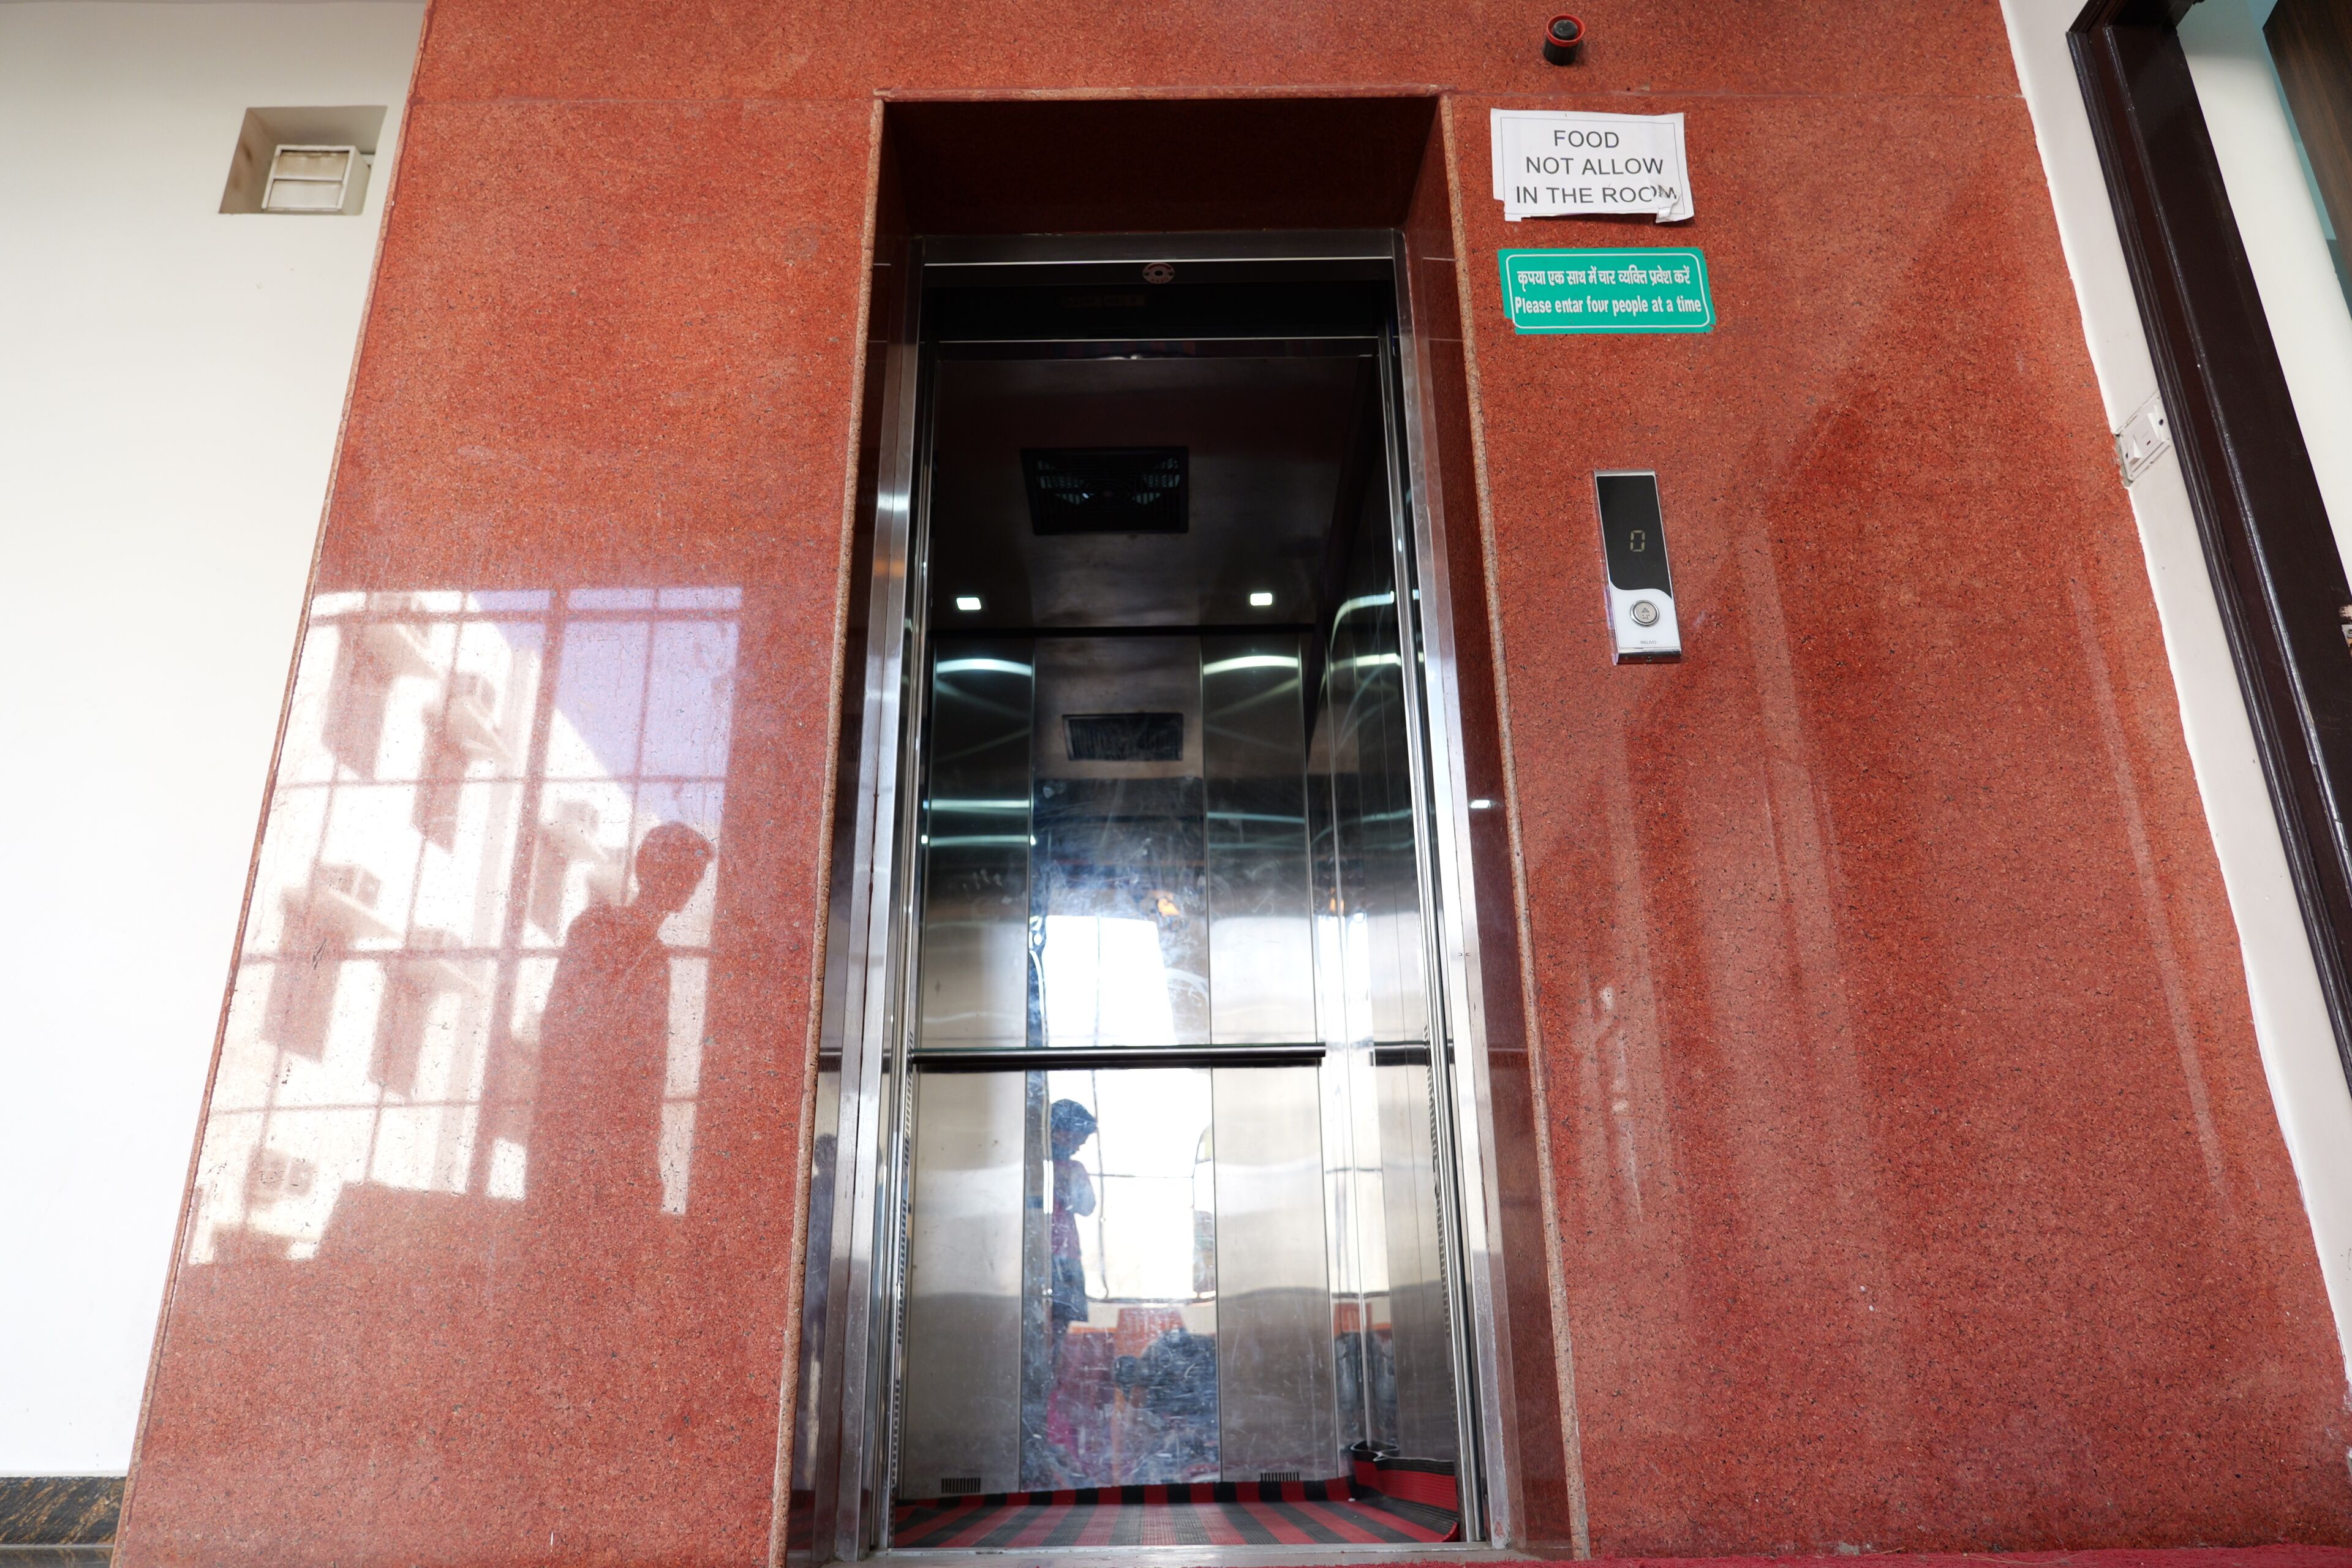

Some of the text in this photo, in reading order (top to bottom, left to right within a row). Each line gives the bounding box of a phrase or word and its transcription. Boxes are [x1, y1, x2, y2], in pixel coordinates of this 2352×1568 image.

[1553, 129, 1619, 148] FOOD
[1526, 156, 1664, 175] NOT ALLOW
[1516, 184, 1678, 204] IN THE ROOM
[1517, 264, 1691, 292] कृपया एक साथ में चार व्यक्ति प्रवेश करें
[1515, 296, 1552, 314] Please
[1586, 295, 1609, 312] four
[1612, 295, 1648, 317] people
[1651, 295, 1664, 312] at
[1666, 298, 1674, 312] a
[1676, 295, 1702, 312] time
[1630, 529, 1645, 552] 0
